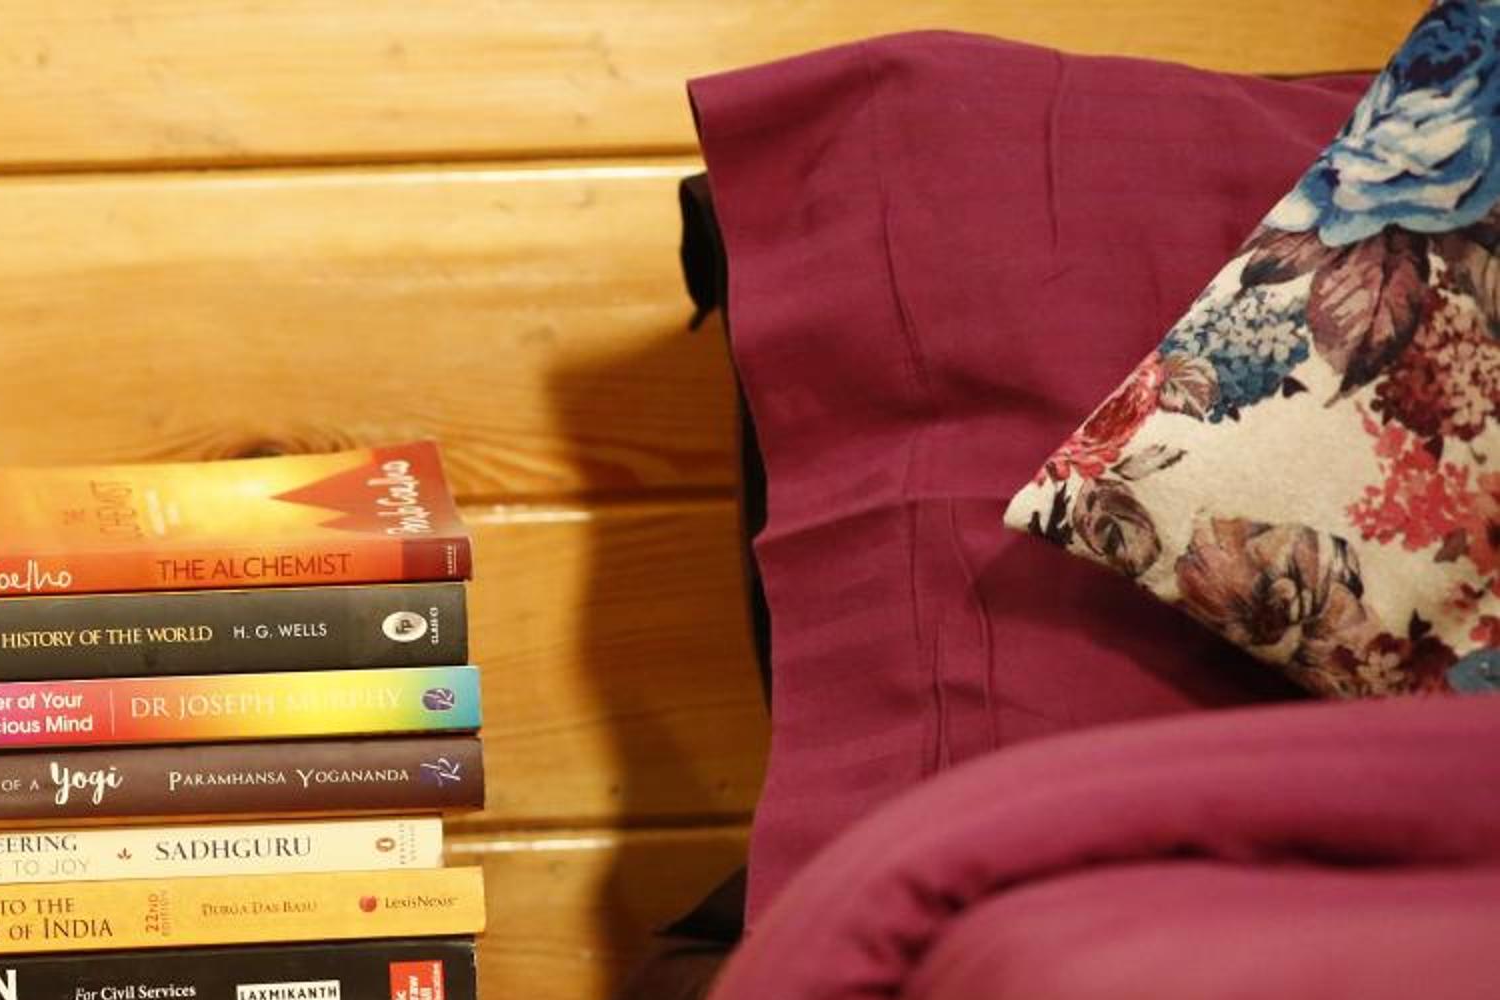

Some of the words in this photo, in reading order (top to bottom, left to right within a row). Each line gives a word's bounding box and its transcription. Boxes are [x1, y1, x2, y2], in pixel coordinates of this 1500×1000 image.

[156, 560, 205, 580] THE
[211, 554, 352, 579] ALCHEMIST
[1, 630, 74, 649] HISTORY
[79, 629, 104, 645] OF
[106, 628, 142, 645] THE
[146, 625, 213, 642] WORLD
[233, 626, 250, 639] H.
[255, 625, 273, 639] G.
[277, 623, 328, 638] WELLS
[17, 694, 37, 709] of
[41, 692, 83, 709] Your
[131, 697, 171, 718] DR
[178, 693, 276, 719] JOSEPH
[45, 714, 93, 733] Mind
[2, 779, 21, 792] OF
[30, 780, 40, 791] A
[50, 762, 123, 805] Yogi
[169, 771, 287, 791] PARAMHANSA
[297, 769, 409, 788] YOGANANDA
[155, 836, 311, 861] SADHGURU
[12, 859, 40, 876] TO
[50, 857, 90, 875] JOY
[1, 899, 25, 915] TO
[37, 897, 76, 913] THE
[9, 924, 33, 941] OF
[43, 918, 113, 940] INDIA
[101, 985, 135, 1000] Civil
[138, 983, 196, 999] Services
